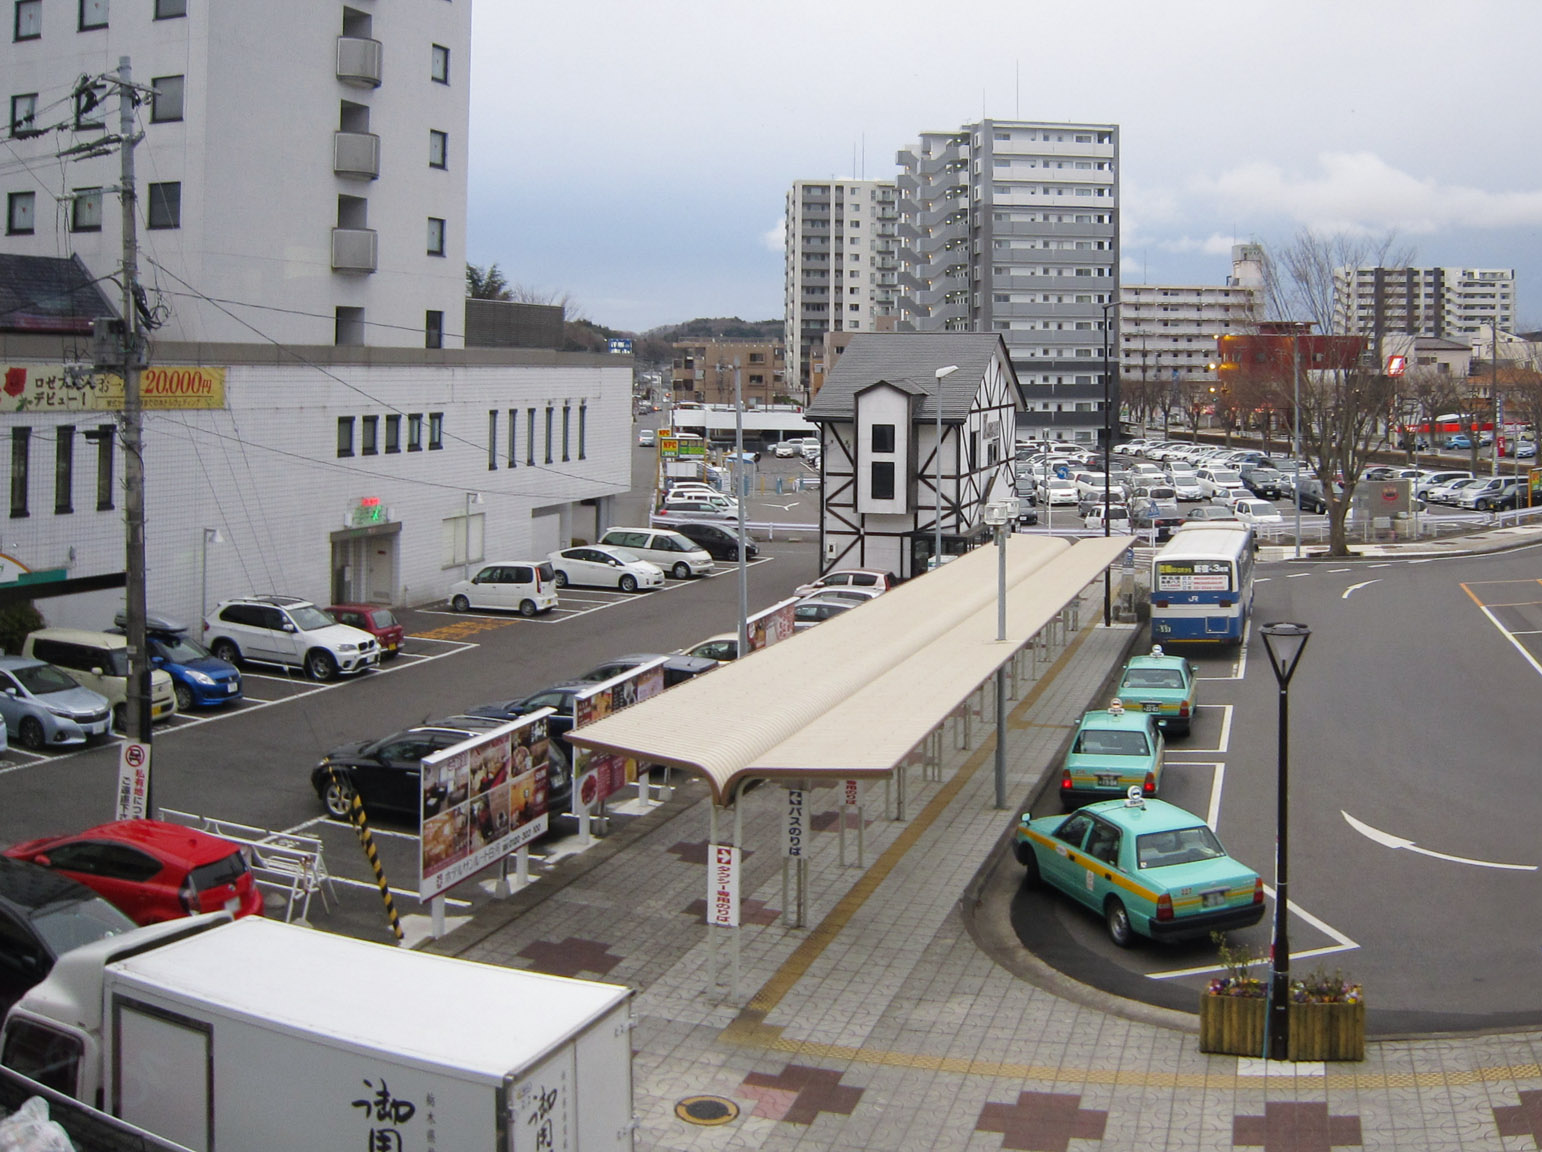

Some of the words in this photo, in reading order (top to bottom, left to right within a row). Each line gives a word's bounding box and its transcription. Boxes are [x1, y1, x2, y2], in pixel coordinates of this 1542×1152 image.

[716, 865, 731, 923] タクシー専用のりば
[426, 1092, 436, 1152] 栃木県
